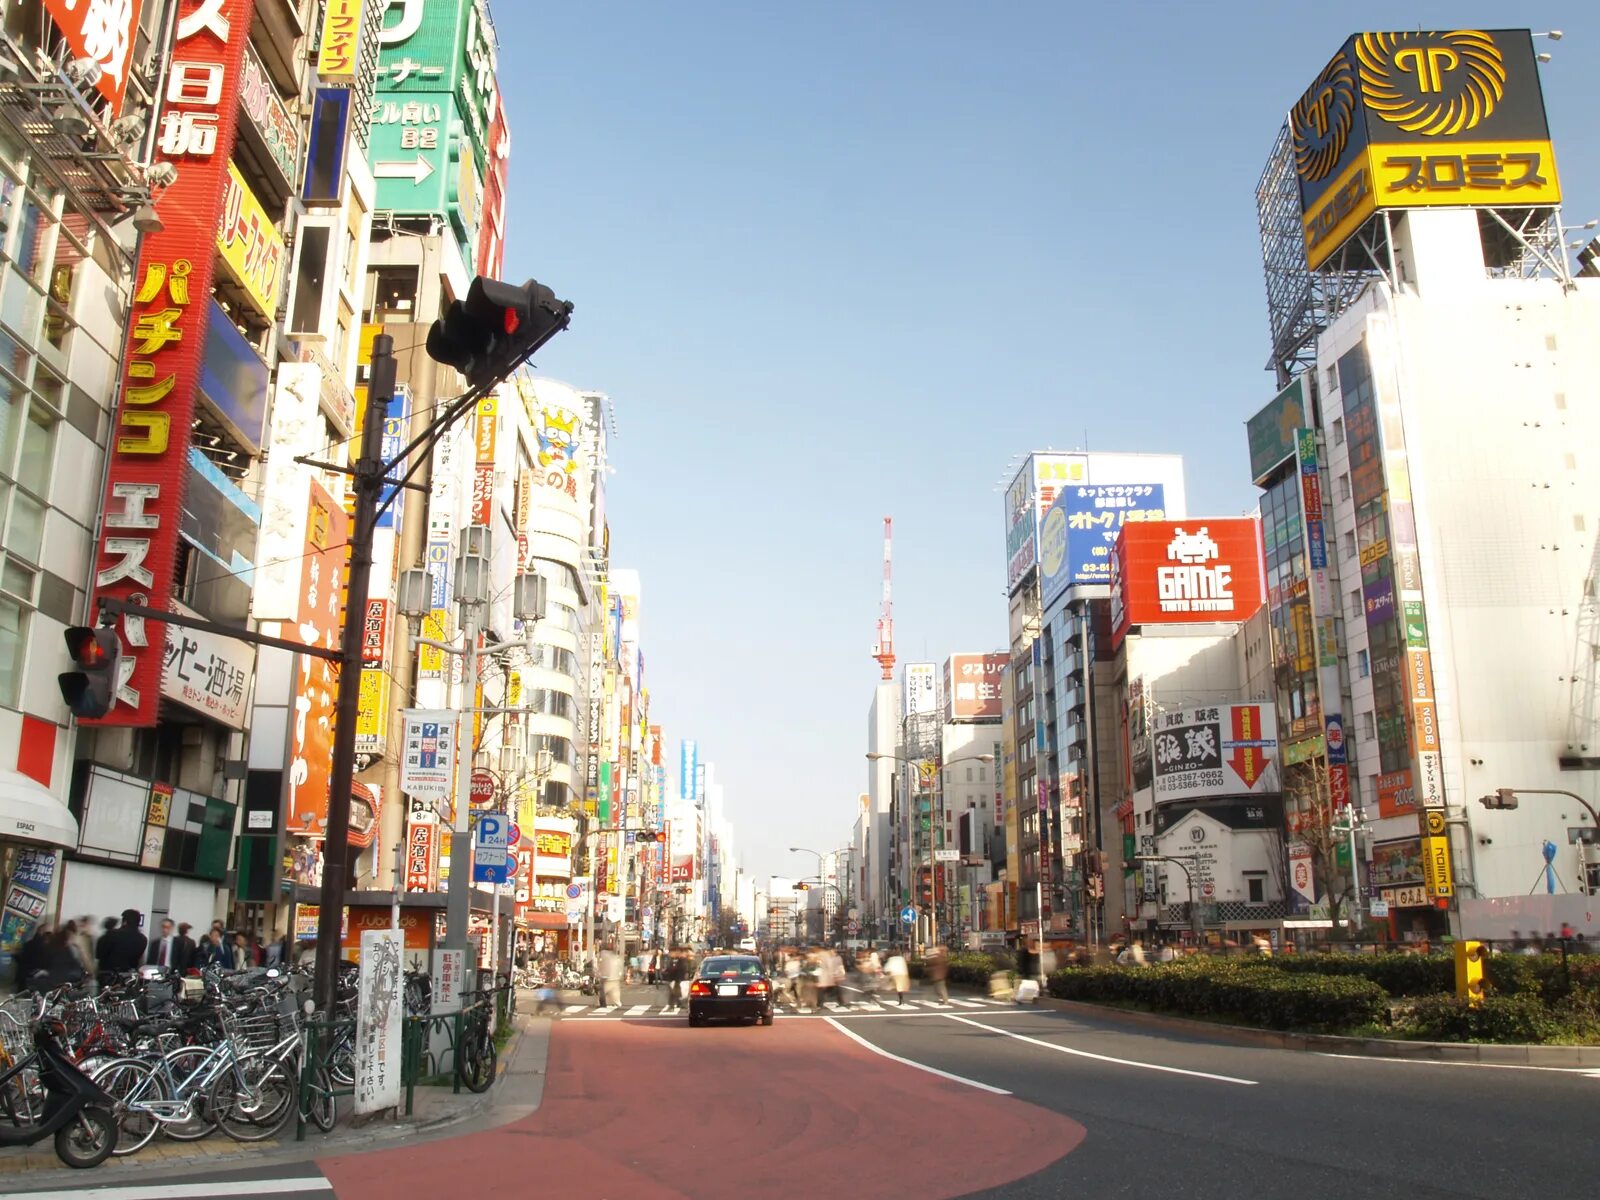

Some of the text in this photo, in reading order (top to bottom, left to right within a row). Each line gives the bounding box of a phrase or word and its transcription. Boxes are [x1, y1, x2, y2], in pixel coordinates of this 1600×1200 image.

[400, 126, 438, 149] B2
[1385, 152, 1548, 192] プロミス
[1307, 168, 1367, 252] プロミス
[116, 258, 191, 455] パチンコ
[1077, 485, 1153, 498] ネットでラクラク
[1157, 565, 1234, 599] GAME
[364, 602, 384, 647] 居酒屋
[1155, 725, 1218, 765] 銀蔵
[1167, 778, 1224, 792] 03-5366-7800
[16, 821, 36, 832] ESPACE
[479, 817, 501, 843] P
[487, 835, 506, 845] 24H
[411, 828, 430, 874] 居酒屋
[356, 913, 418, 928] Subnde
[440, 953, 452, 1003] 駐停車禁止
